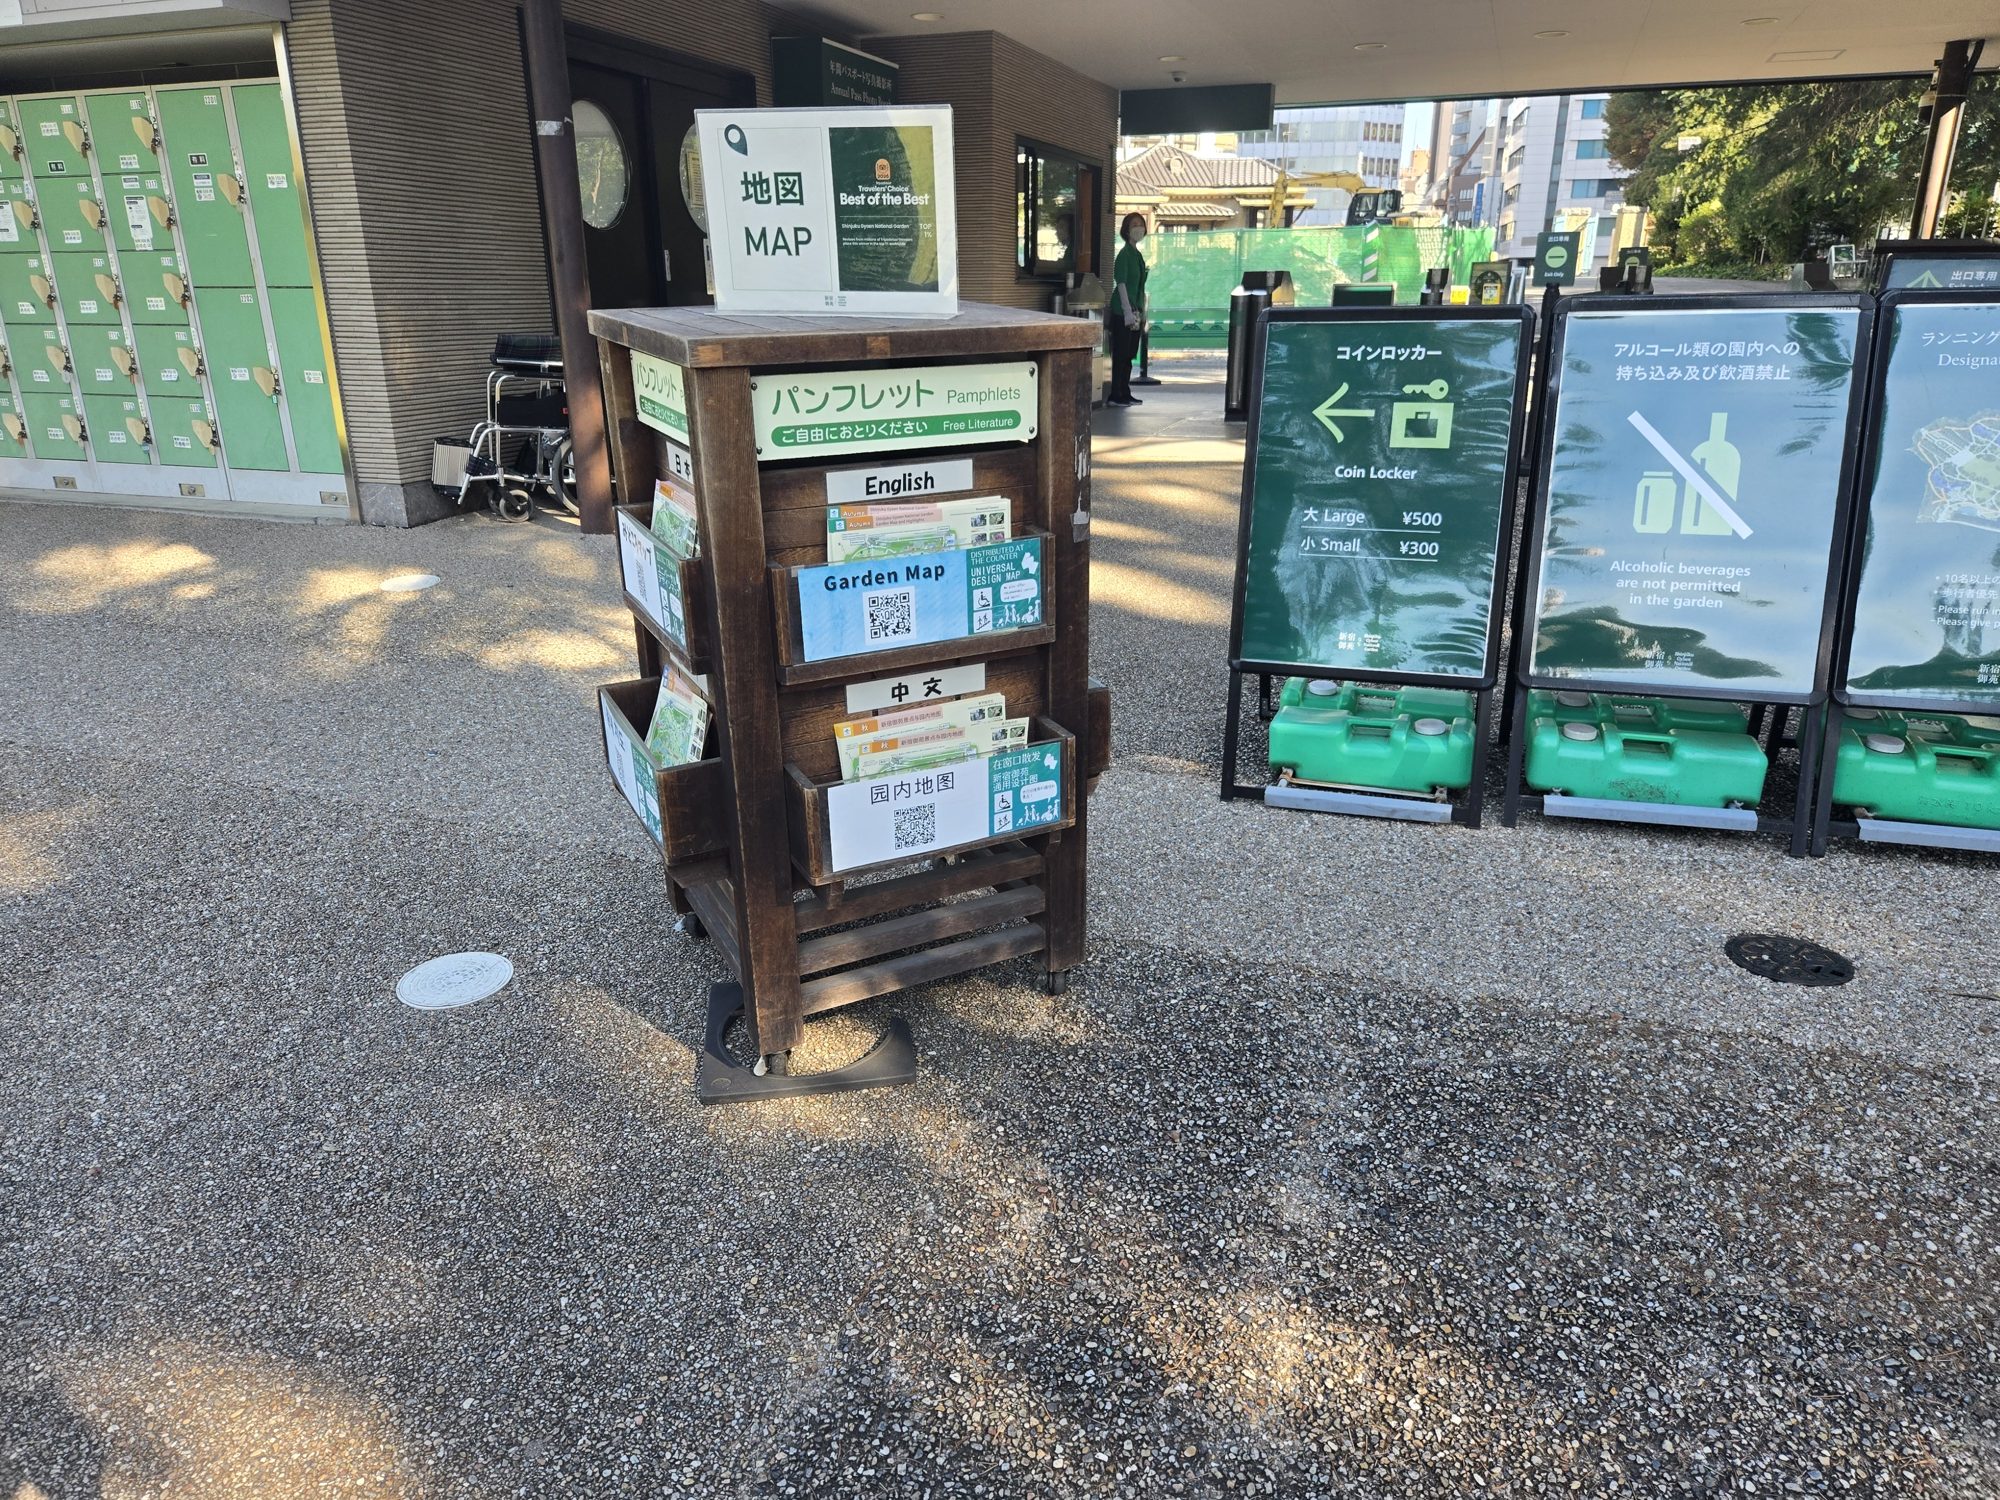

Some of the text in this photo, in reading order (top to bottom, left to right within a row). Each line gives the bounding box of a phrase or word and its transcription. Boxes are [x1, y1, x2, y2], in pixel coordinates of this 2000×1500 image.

[740, 171, 804, 206] 地図
[840, 193, 930, 206] Best of the Best
[744, 226, 812, 256] MAP
[1951, 270, 1998, 281] 出口専用
[1336, 344, 1442, 361] コインロッカー
[1614, 341, 1800, 358] アルコール類の園内への
[637, 362, 677, 400] パンフレット
[1616, 364, 1791, 382] 持ち込み及び飲酒禁止
[772, 379, 1021, 415] パンフレット Pamphlets
[781, 417, 1014, 444] ご自由におとりください Free Literature
[1334, 465, 1418, 480] Coin Locker
[864, 471, 935, 497] English
[1302, 506, 1442, 527] 大 Large ¥500
[970, 544, 1025, 559] DISTRIBUTED AT
[1301, 535, 1439, 556] 小 Small ¥300
[971, 552, 1018, 566] THE COUNTER
[823, 563, 945, 593] Garden Map
[970, 561, 1016, 578] UNIVERSAL
[971, 570, 1021, 587] DESIGN MAP
[1610, 560, 1752, 579] Alcoholic beverages
[1616, 579, 1742, 593] are not permitted
[1629, 593, 1723, 609] in the garden
[1972, 607, 1989, 616] run
[1970, 618, 1991, 630] give
[891, 676, 943, 703] 中文
[993, 750, 1041, 771] 在窗口散发
[870, 771, 955, 805] 园内地图
